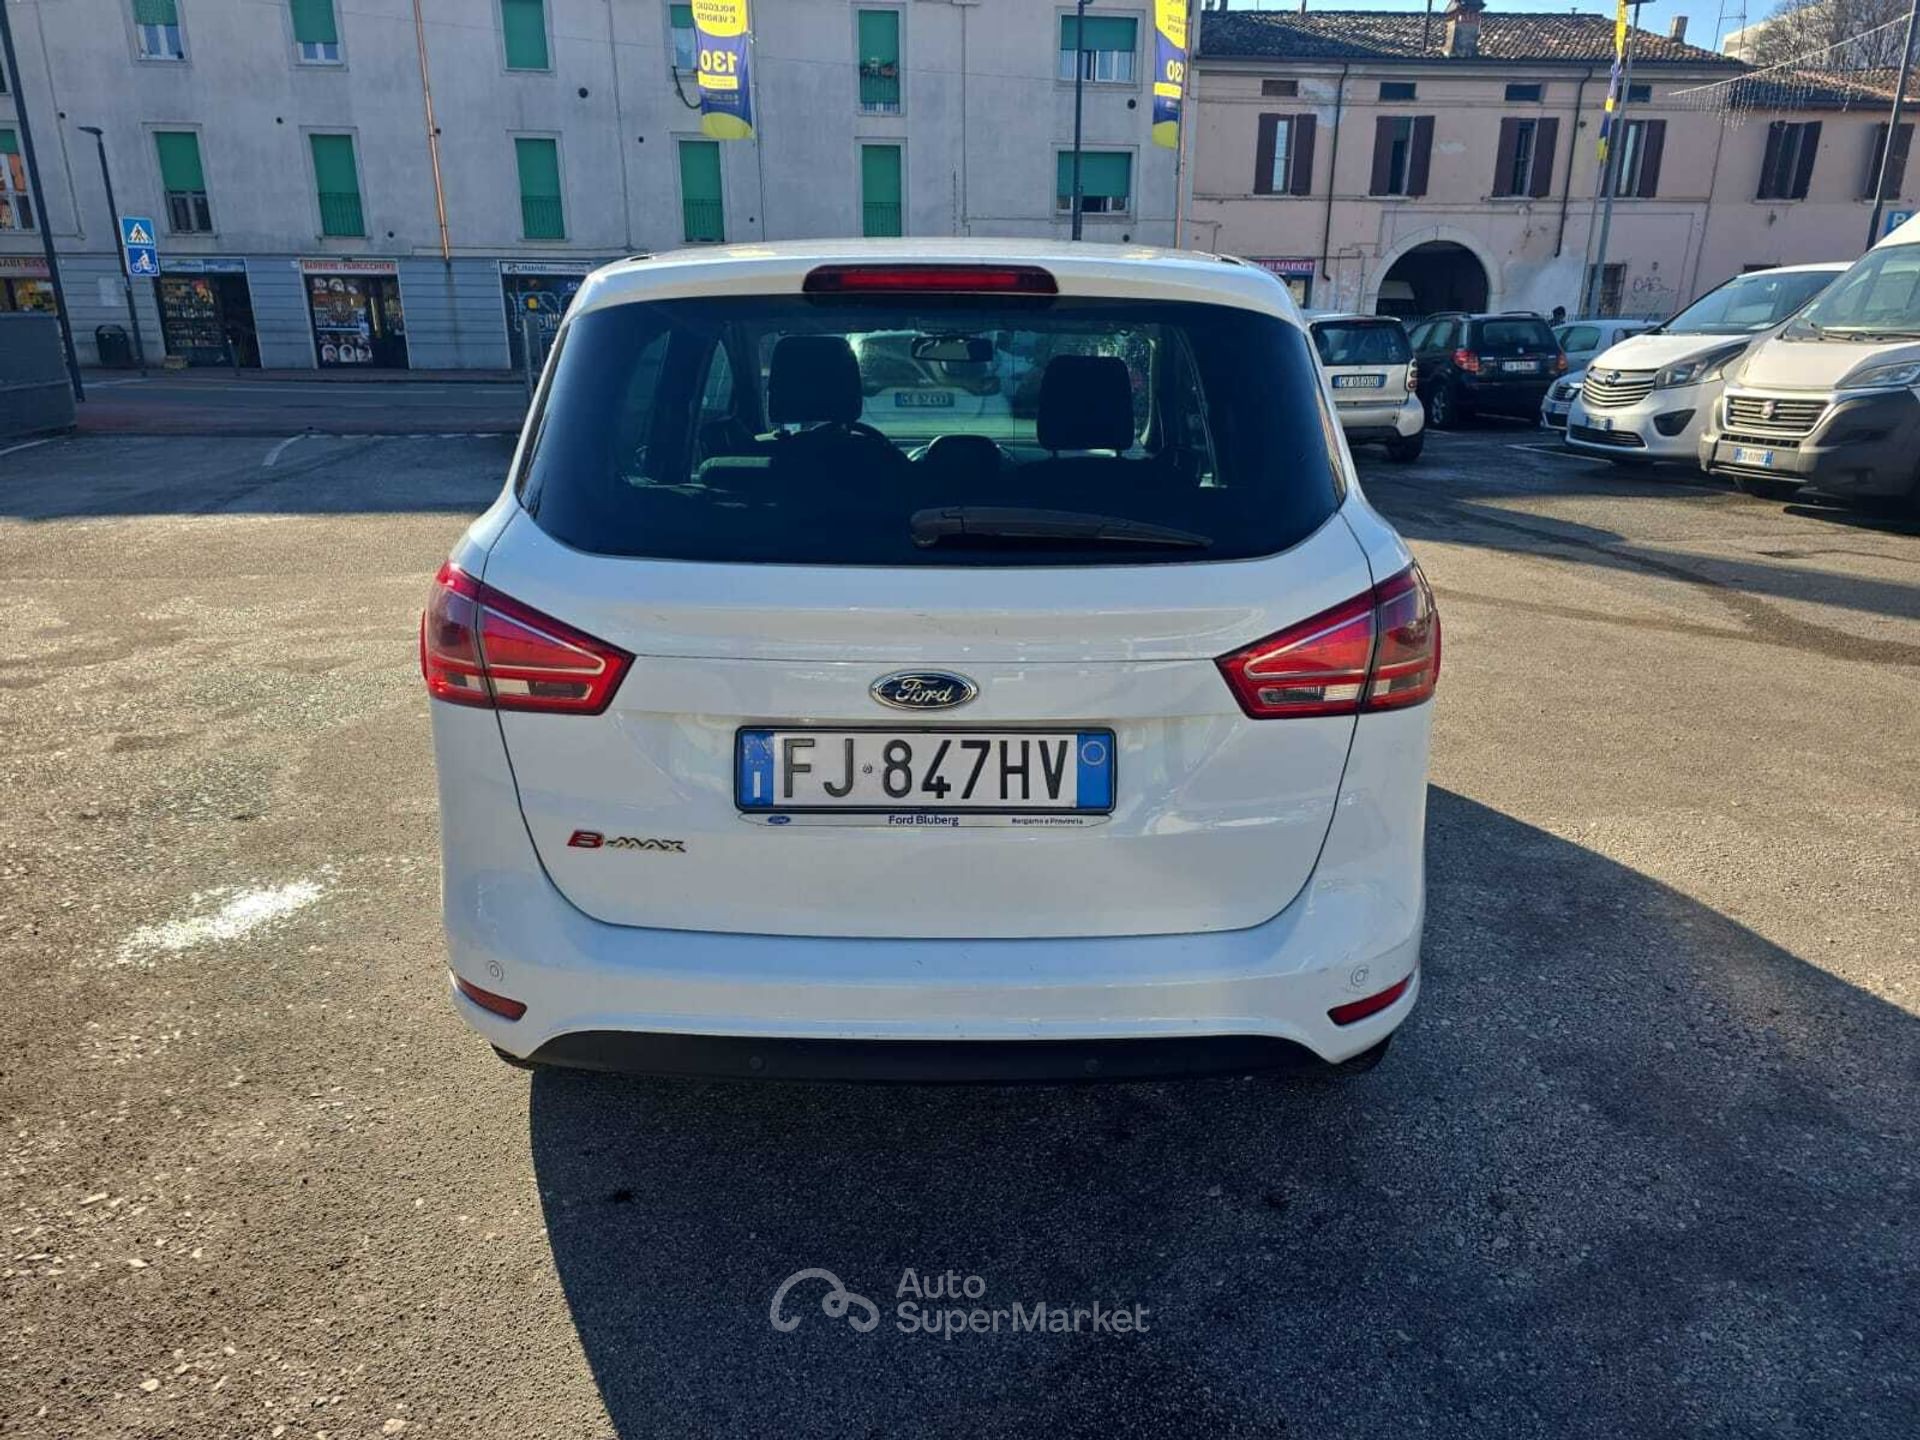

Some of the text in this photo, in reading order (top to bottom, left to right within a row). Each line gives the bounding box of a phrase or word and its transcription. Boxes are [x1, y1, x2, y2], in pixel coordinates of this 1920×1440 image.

[895, 679, 954, 702] Ford
[881, 739, 1069, 801] 847HV
[888, 814, 914, 825] Ford
[916, 814, 960, 827] Bluberg
[1011, 816, 1044, 826] Bergamo
[1050, 816, 1084, 825] Provincia
